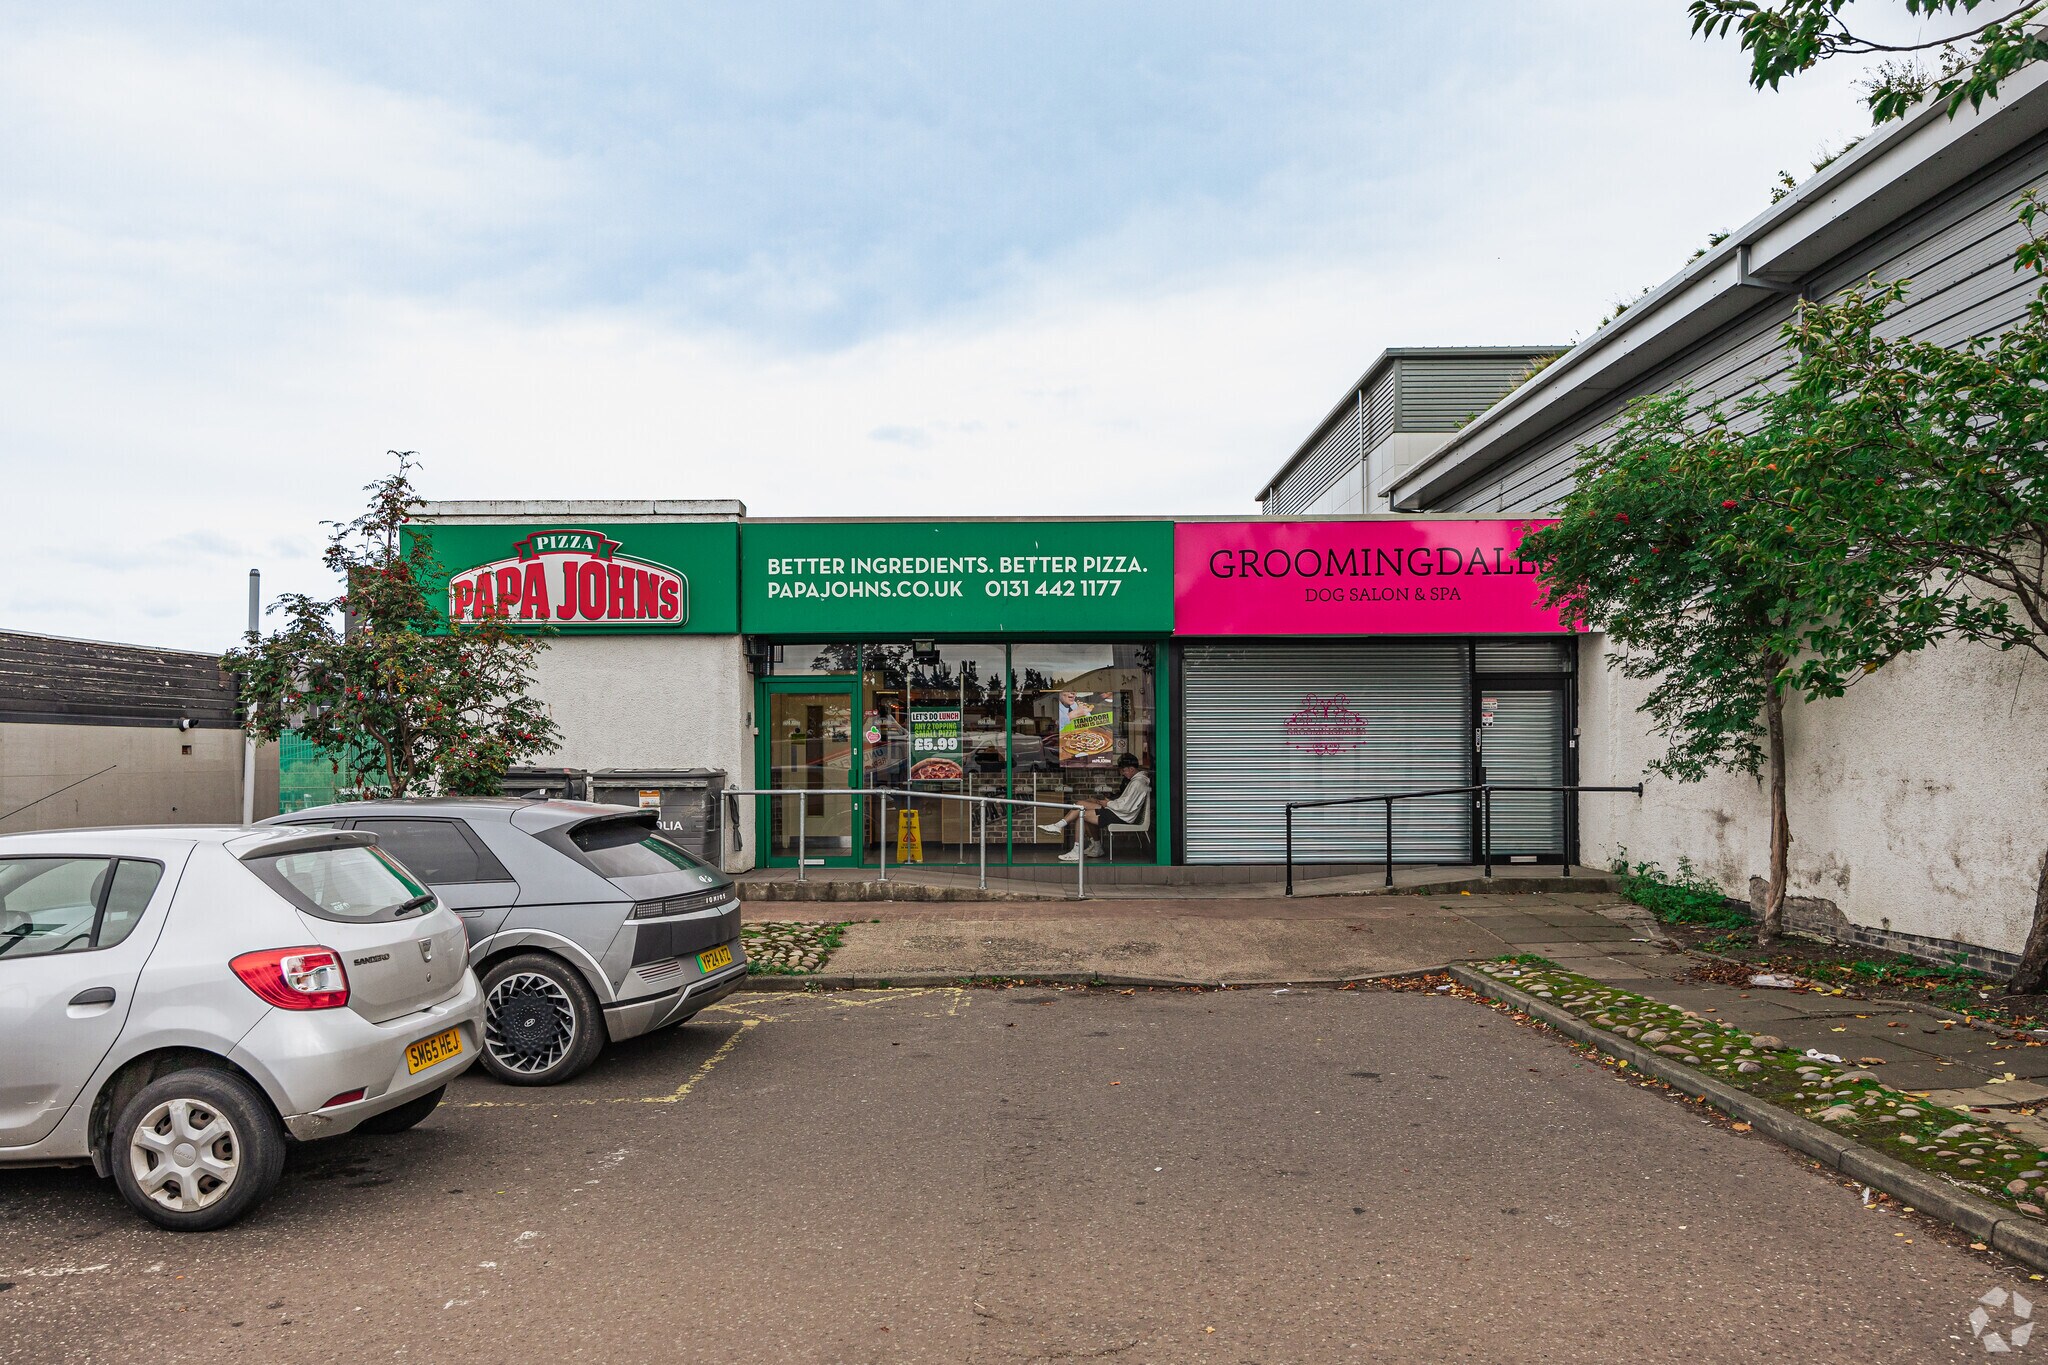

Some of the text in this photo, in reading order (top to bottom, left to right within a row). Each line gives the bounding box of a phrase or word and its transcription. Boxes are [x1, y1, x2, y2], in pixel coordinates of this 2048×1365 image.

[536, 535, 594, 550] PIZZA
[768, 556, 1148, 575] BETTER INGREDIENTS. BETTER PIZZA.
[1209, 547, 1546, 578] GROOMINGDALE
[454, 561, 679, 620] PAPA JOHN'S
[768, 580, 1122, 598] PAPAJOHNS.CO.UK 0131 442 1177
[1305, 587, 1462, 602] DOG SALON & SPA
[929, 712, 938, 720] DO
[939, 712, 959, 720] LUNCH
[914, 729, 957, 738] SMALL PIZZA
[932, 722, 957, 730] TOPPING
[914, 738, 958, 751] £5.99
[353, 953, 390, 966] SANDERO
[410, 1031, 459, 1067] SM65 HEJ
